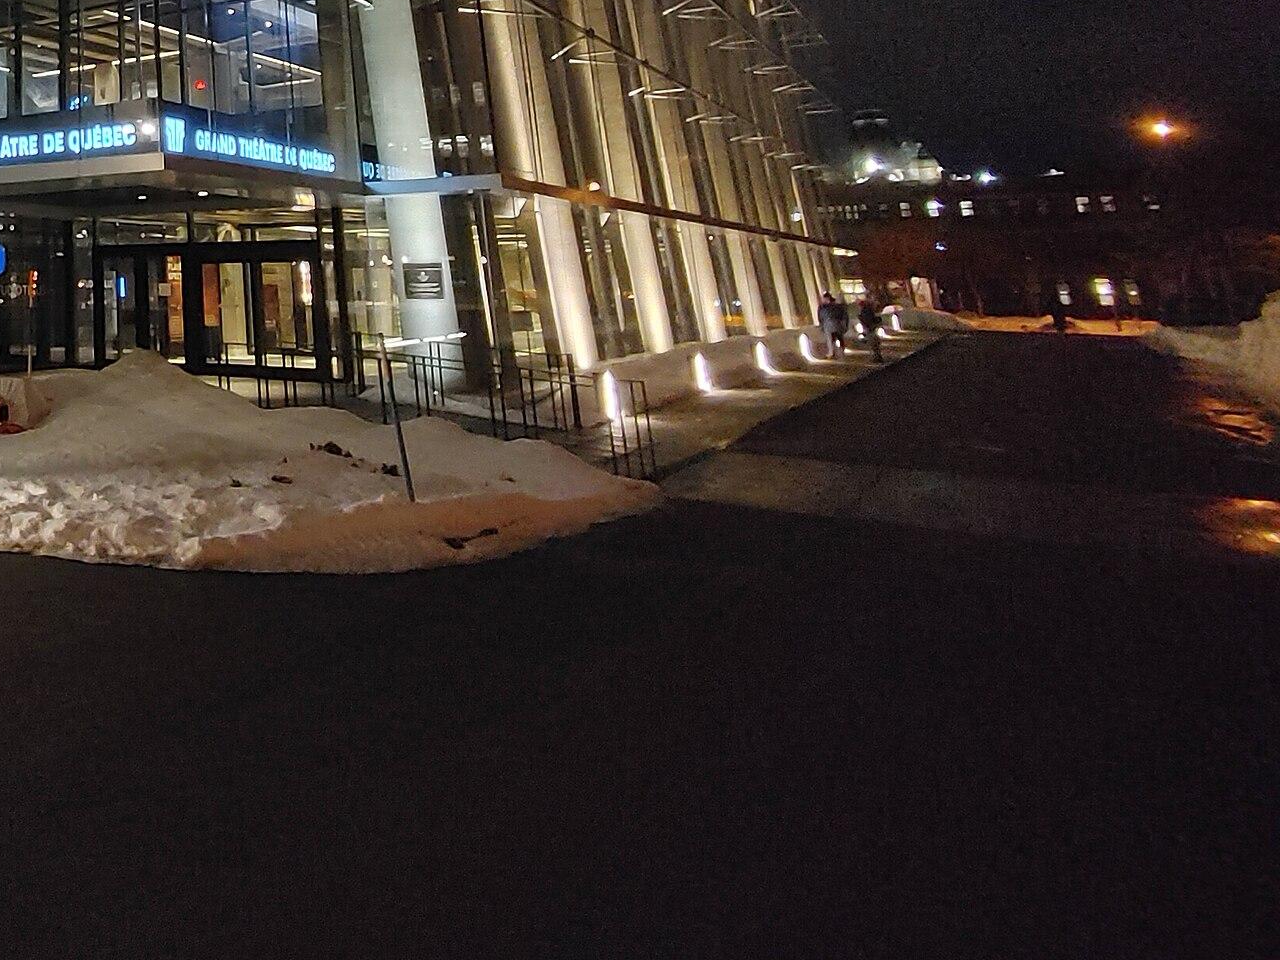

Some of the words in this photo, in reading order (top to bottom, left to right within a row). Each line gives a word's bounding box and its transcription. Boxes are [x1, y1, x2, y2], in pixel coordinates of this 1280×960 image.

[43, 131, 65, 154] DE
[68, 123, 137, 154] QUÉBEC
[195, 129, 237, 156] GRAND
